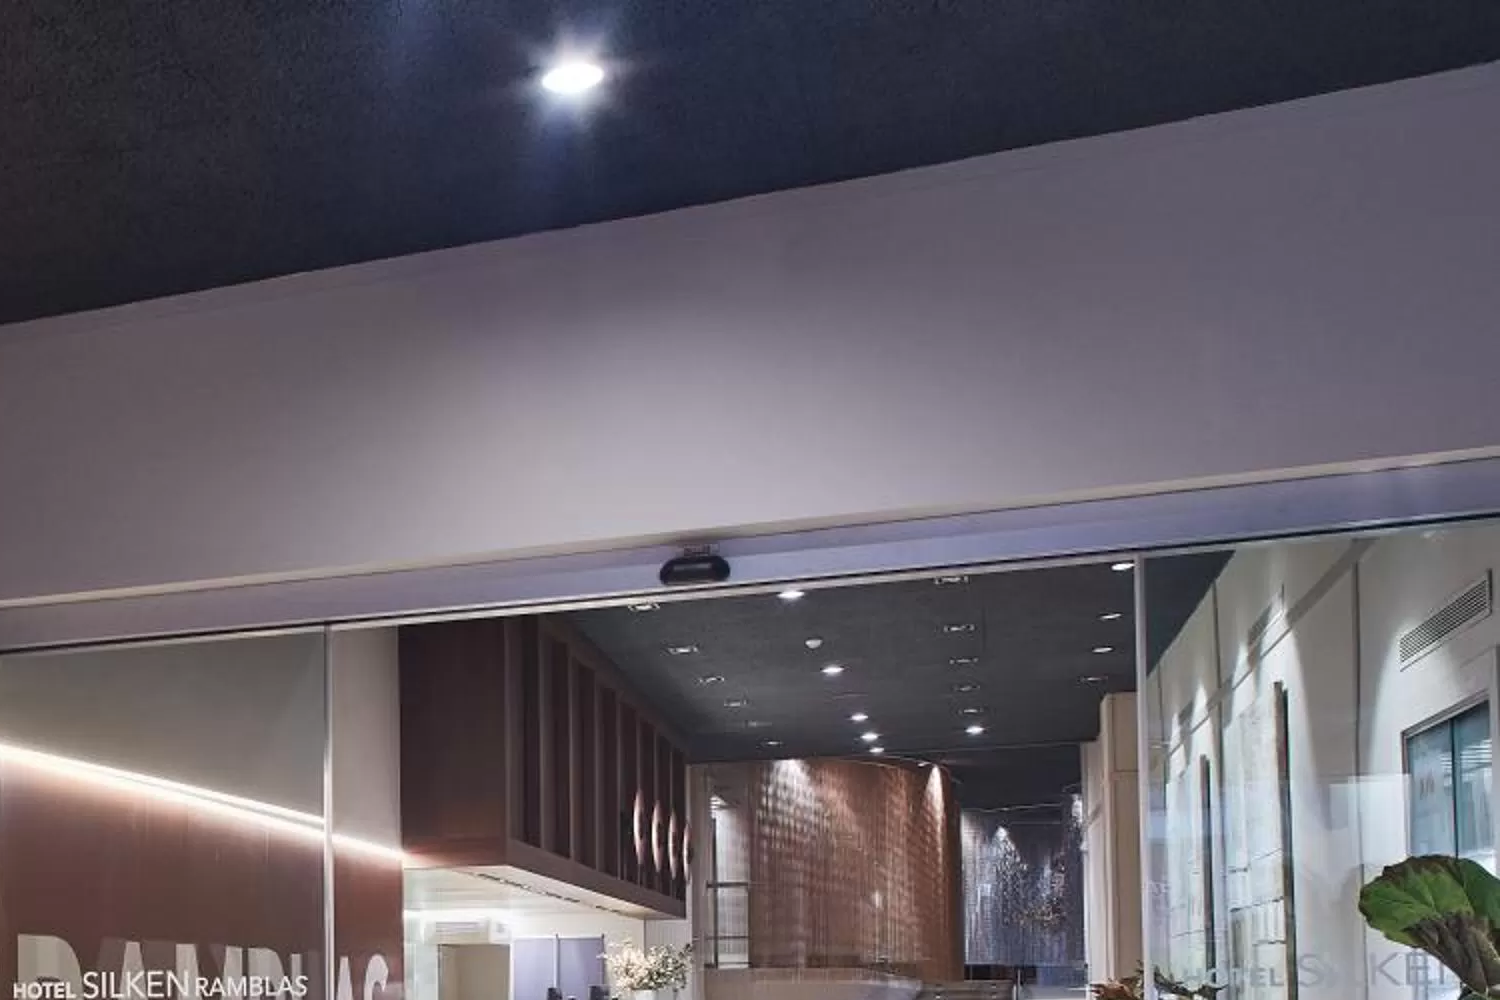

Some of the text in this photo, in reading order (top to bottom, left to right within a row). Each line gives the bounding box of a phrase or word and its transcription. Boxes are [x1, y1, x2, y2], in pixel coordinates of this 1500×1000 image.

[13, 970, 309, 999] HOTEL SILKEN RAMBLAS
